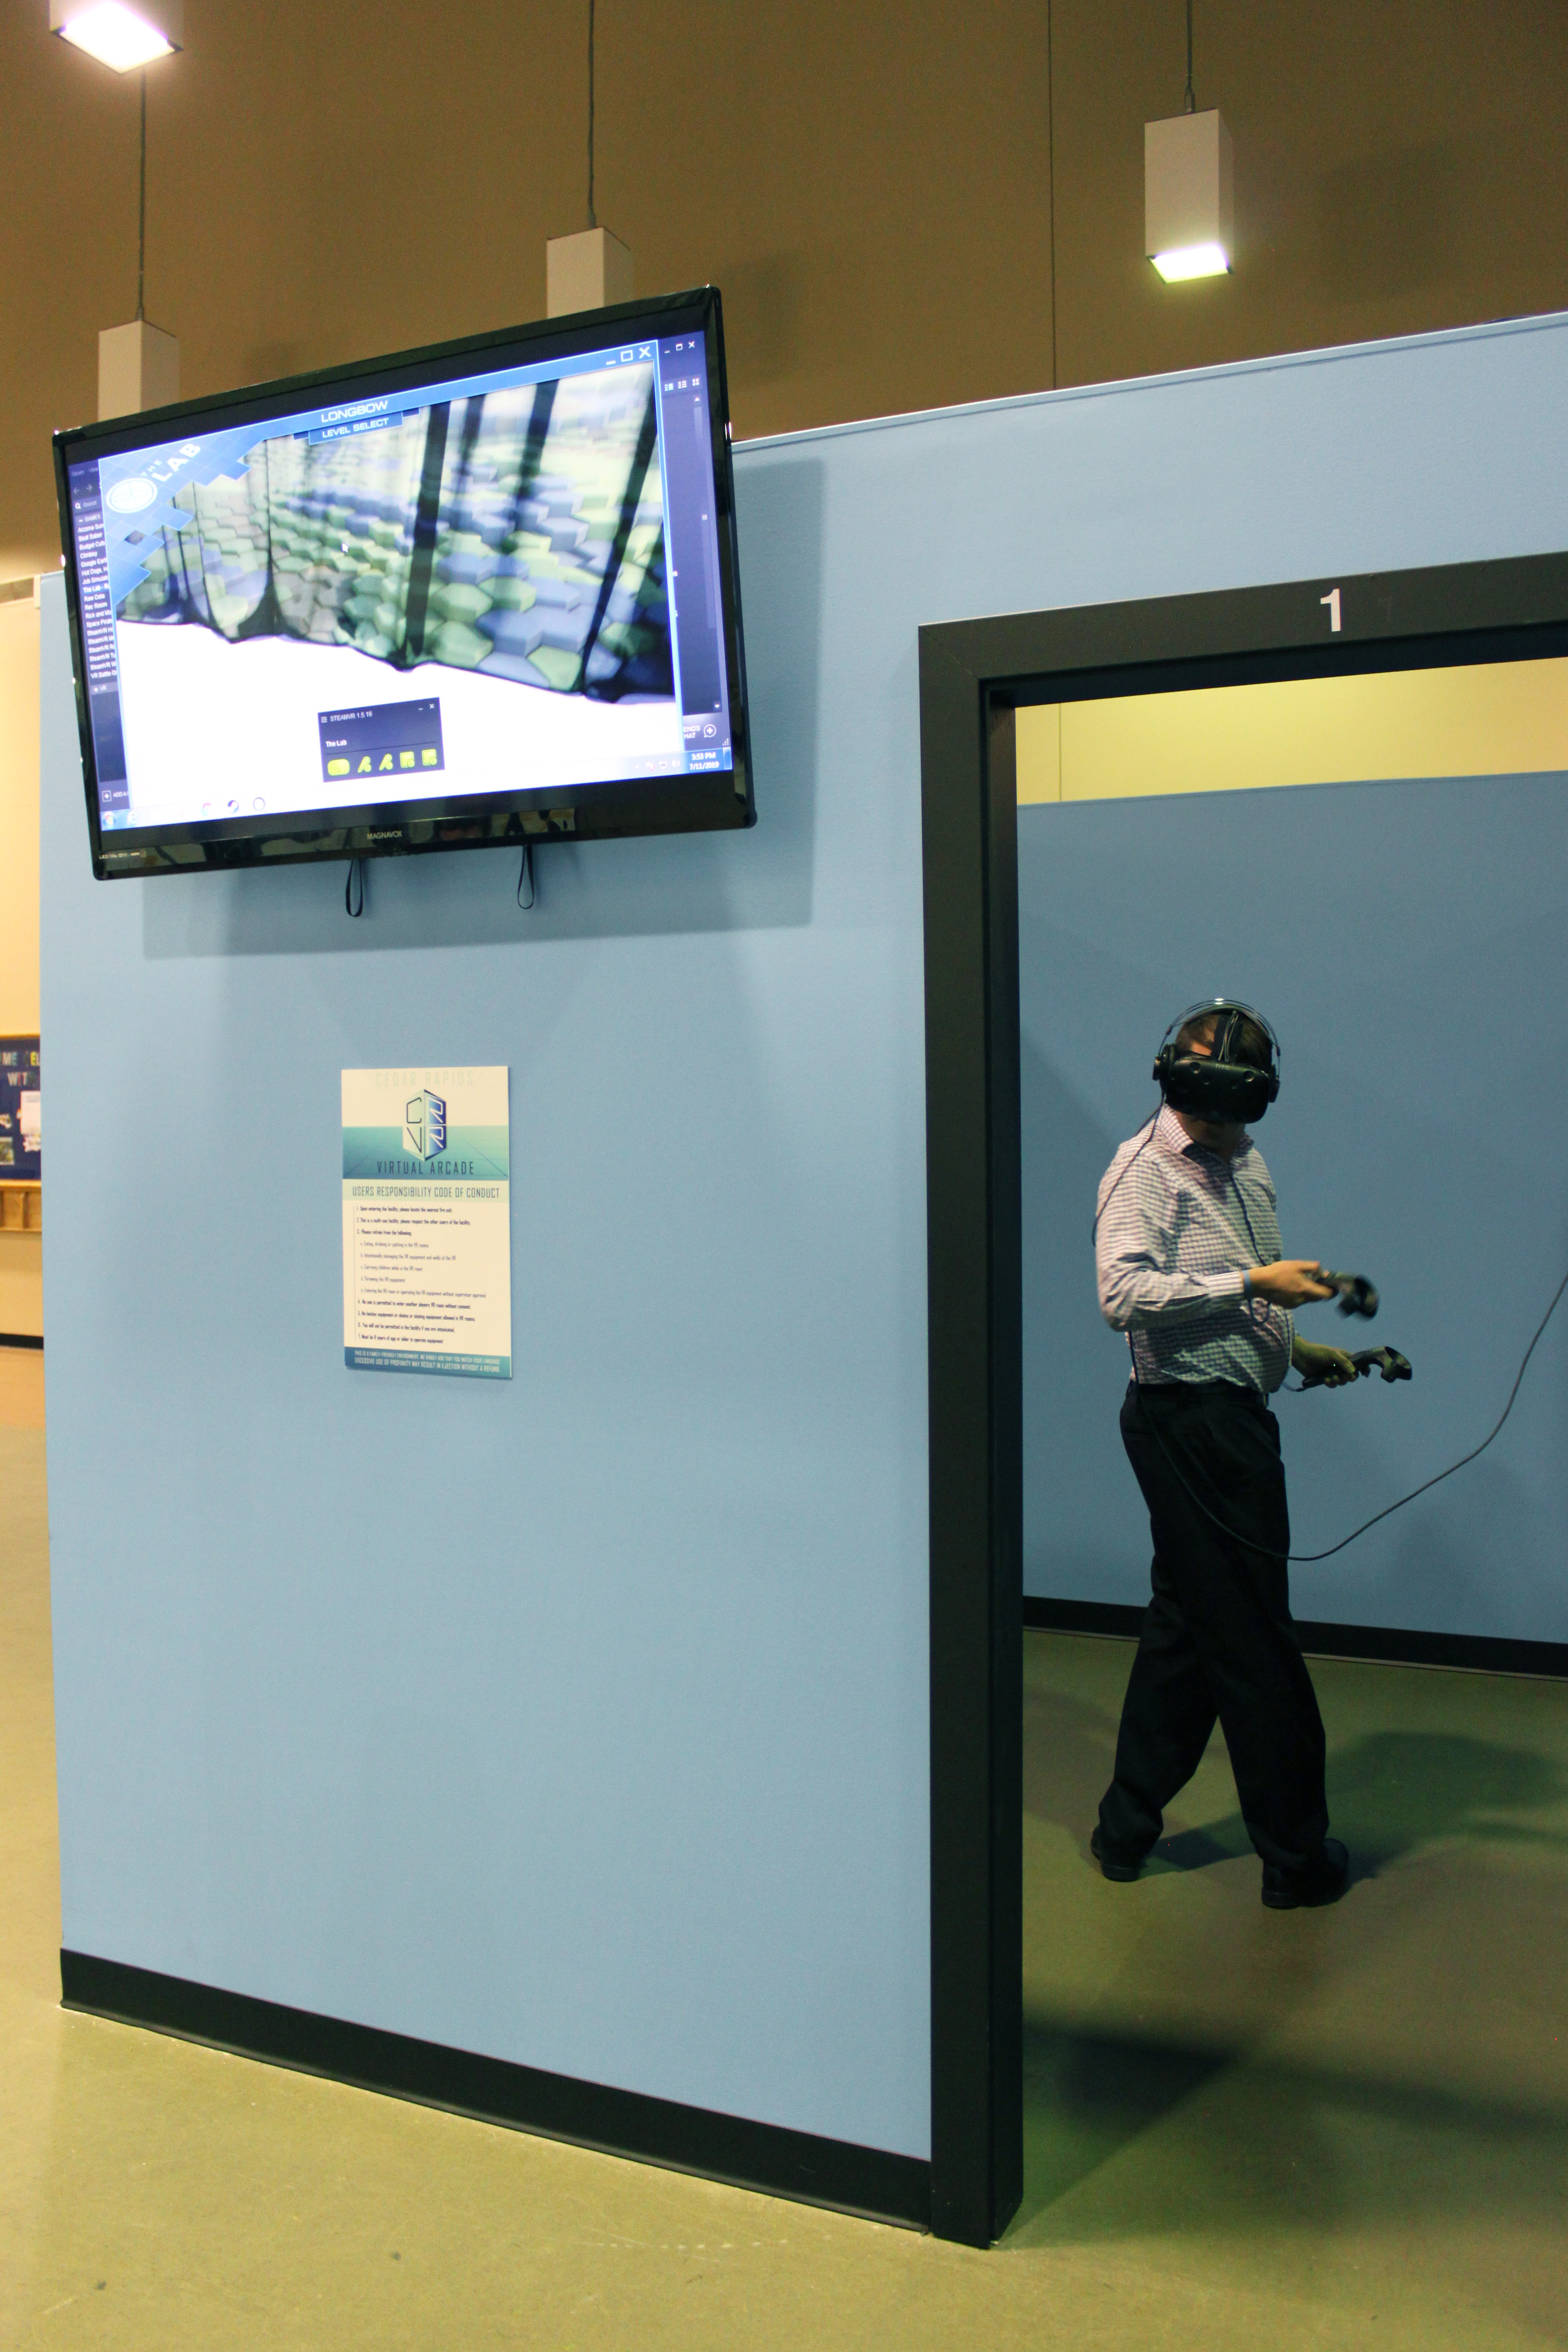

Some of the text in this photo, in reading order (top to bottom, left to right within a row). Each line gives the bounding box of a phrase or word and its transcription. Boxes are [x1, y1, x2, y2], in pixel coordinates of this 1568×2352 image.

[321, 400, 388, 423] LONGBOW
[322, 418, 389, 438] LEVEL SELECT
[140, 460, 162, 476] THE
[151, 443, 201, 482] LAB
[85, 514, 101, 522] GAMES
[1321, 588, 1341, 632] 1
[330, 713, 355, 722] STEAMVR
[689, 761, 719, 771] 7/11/2019
[367, 831, 402, 840] MAGNAVOX
[376, 1071, 474, 1087] CEDAR RAPIDS
[377, 1161, 474, 1175] VIRTUAL ARCADE
[352, 1186, 499, 1198] USERS RESPONSIBILITY CODE OF CONDUCT
